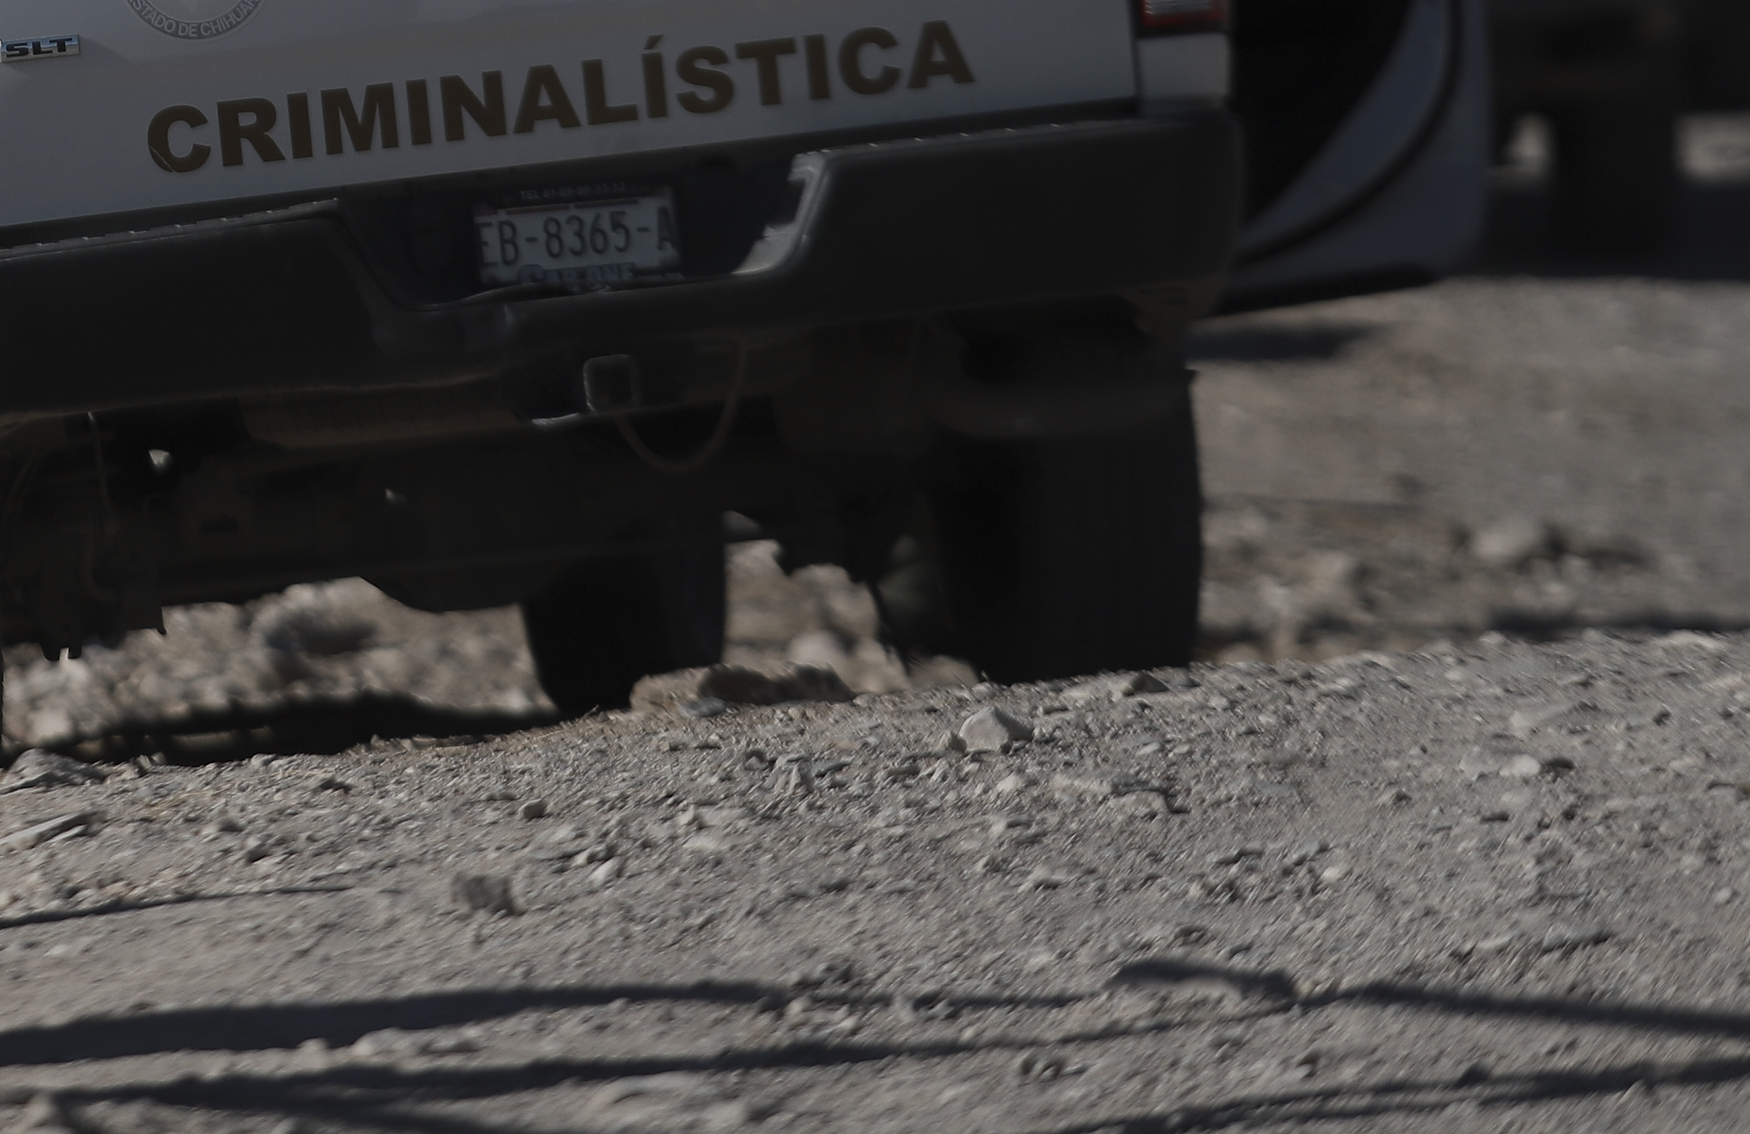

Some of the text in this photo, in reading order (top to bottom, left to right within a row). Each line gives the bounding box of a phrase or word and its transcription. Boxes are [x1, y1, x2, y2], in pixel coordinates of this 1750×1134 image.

[177, 23, 199, 38] DE
[5, 38, 73, 57] SLT
[146, 19, 976, 174] CRIMINALÍSTICA
[519, 188, 540, 200] TEL
